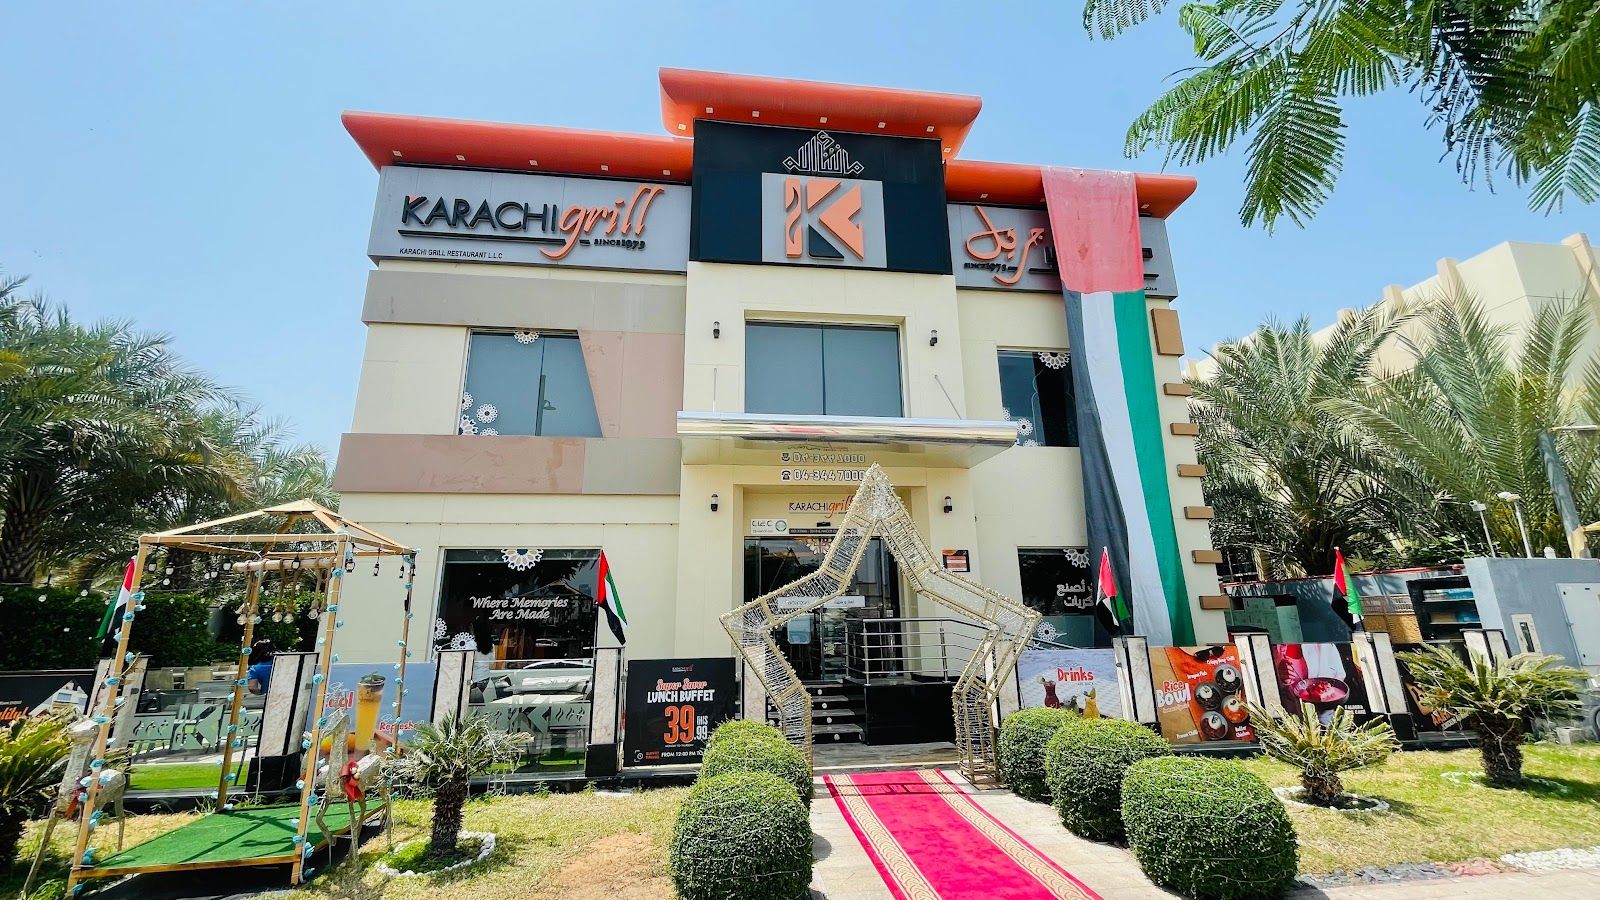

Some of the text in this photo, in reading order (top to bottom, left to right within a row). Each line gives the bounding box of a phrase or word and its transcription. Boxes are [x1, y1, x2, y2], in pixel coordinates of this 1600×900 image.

[401, 184, 665, 260] KARACHI grill
[400, 247, 427, 256] KARACHI
[428, 249, 446, 257] GRILL
[447, 250, 487, 258] RESTAURANT
[794, 469, 836, 481] 04-344
[789, 502, 828, 511] KARACHI
[470, 596, 569, 609] Where Memories
[489, 607, 551, 620] Are Made
[1056, 666, 1094, 682] Drinks
[1163, 680, 1183, 693] Rice
[647, 689, 715, 703] LUNCH BUFFET
[663, 704, 695, 744] 39
